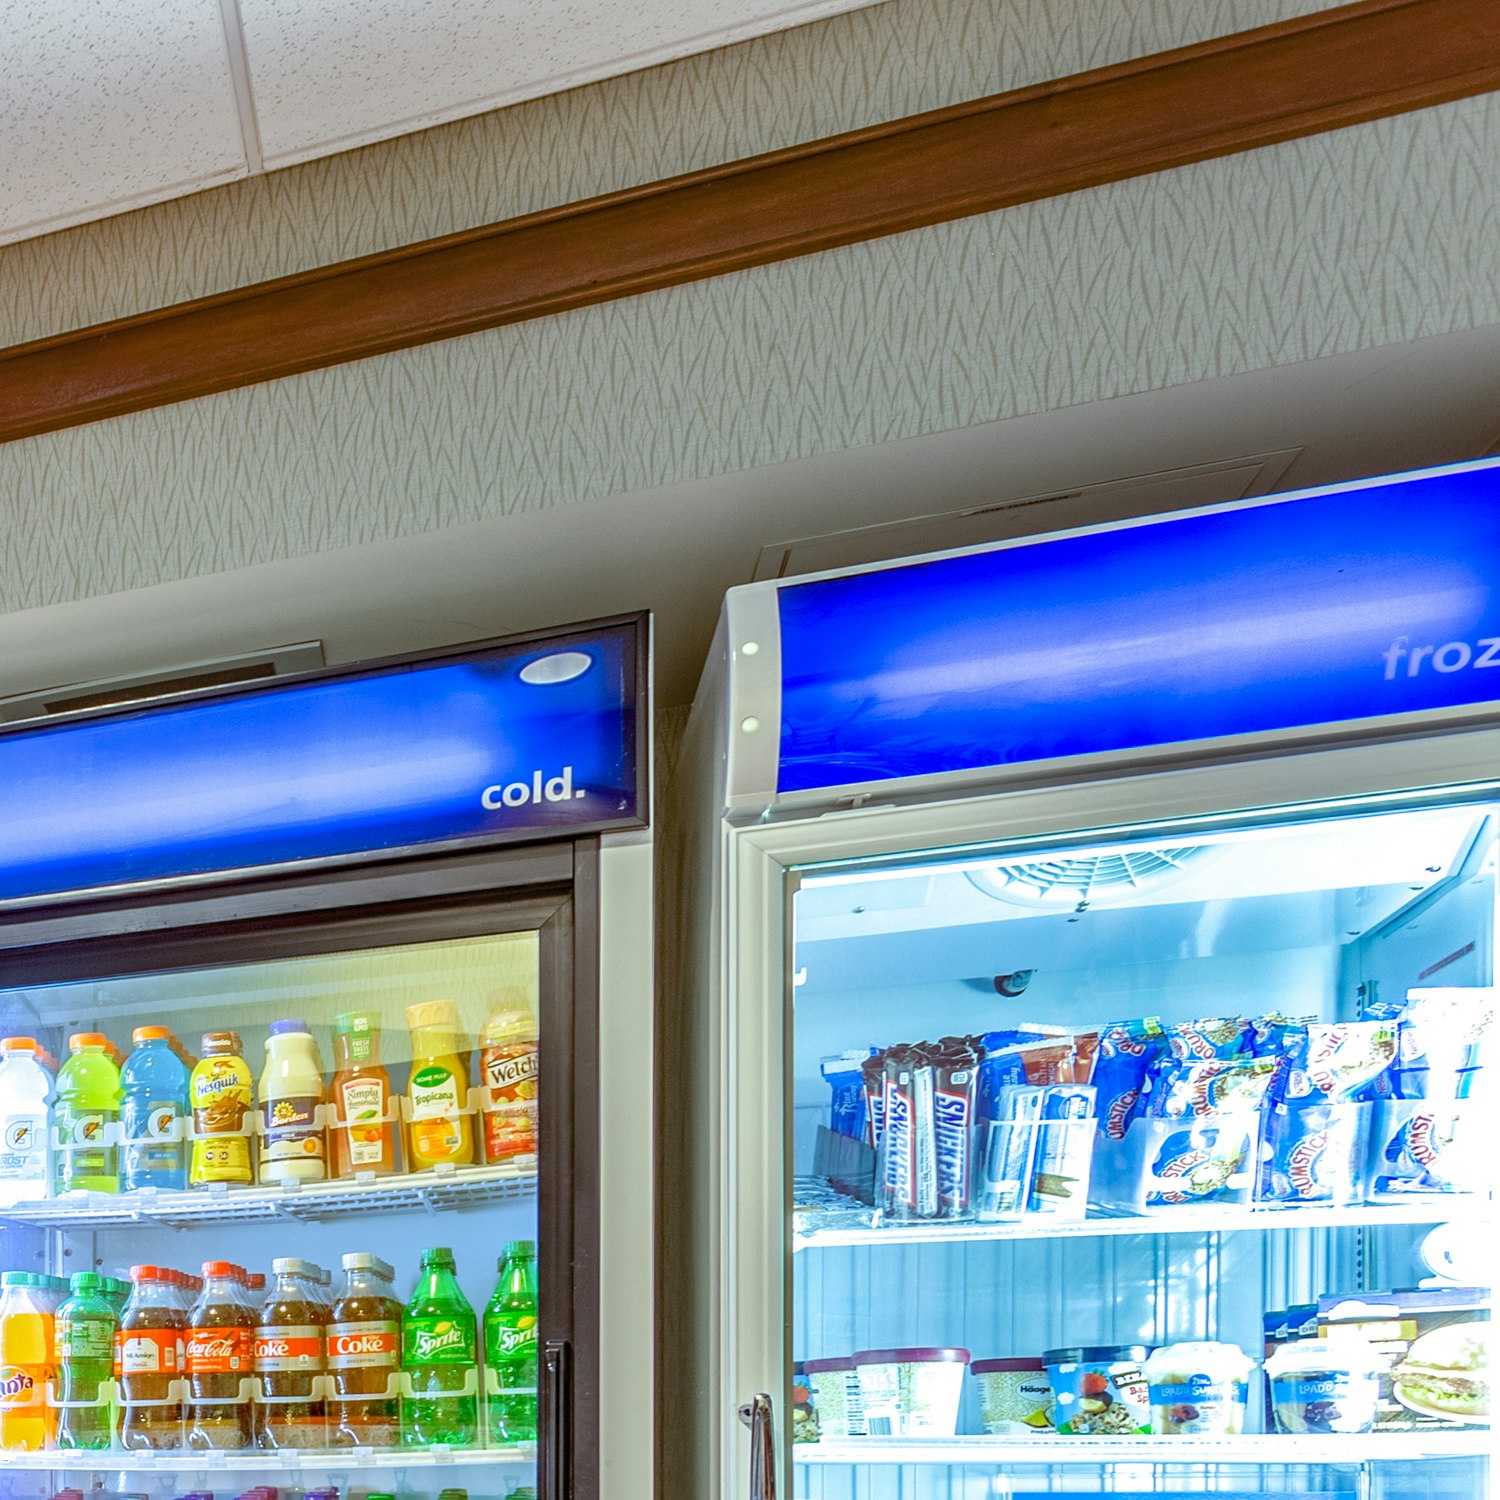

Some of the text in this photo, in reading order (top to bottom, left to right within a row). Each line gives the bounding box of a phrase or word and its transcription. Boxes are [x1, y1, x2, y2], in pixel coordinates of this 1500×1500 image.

[481, 766, 586, 811] cold.
[197, 1073, 239, 1097] Nesquik
[433, 1072, 447, 1081] PULP
[347, 1088, 380, 1103] Simply
[415, 1091, 454, 1106] Tropicana
[73, 1114, 104, 1144] G
[148, 1106, 177, 1138] G
[270, 1112, 309, 1128] Borden
[5, 1120, 35, 1151] G
[254, 1339, 289, 1357] Coke
[336, 1336, 384, 1354] Coke
[418, 1329, 462, 1352] Sprite
